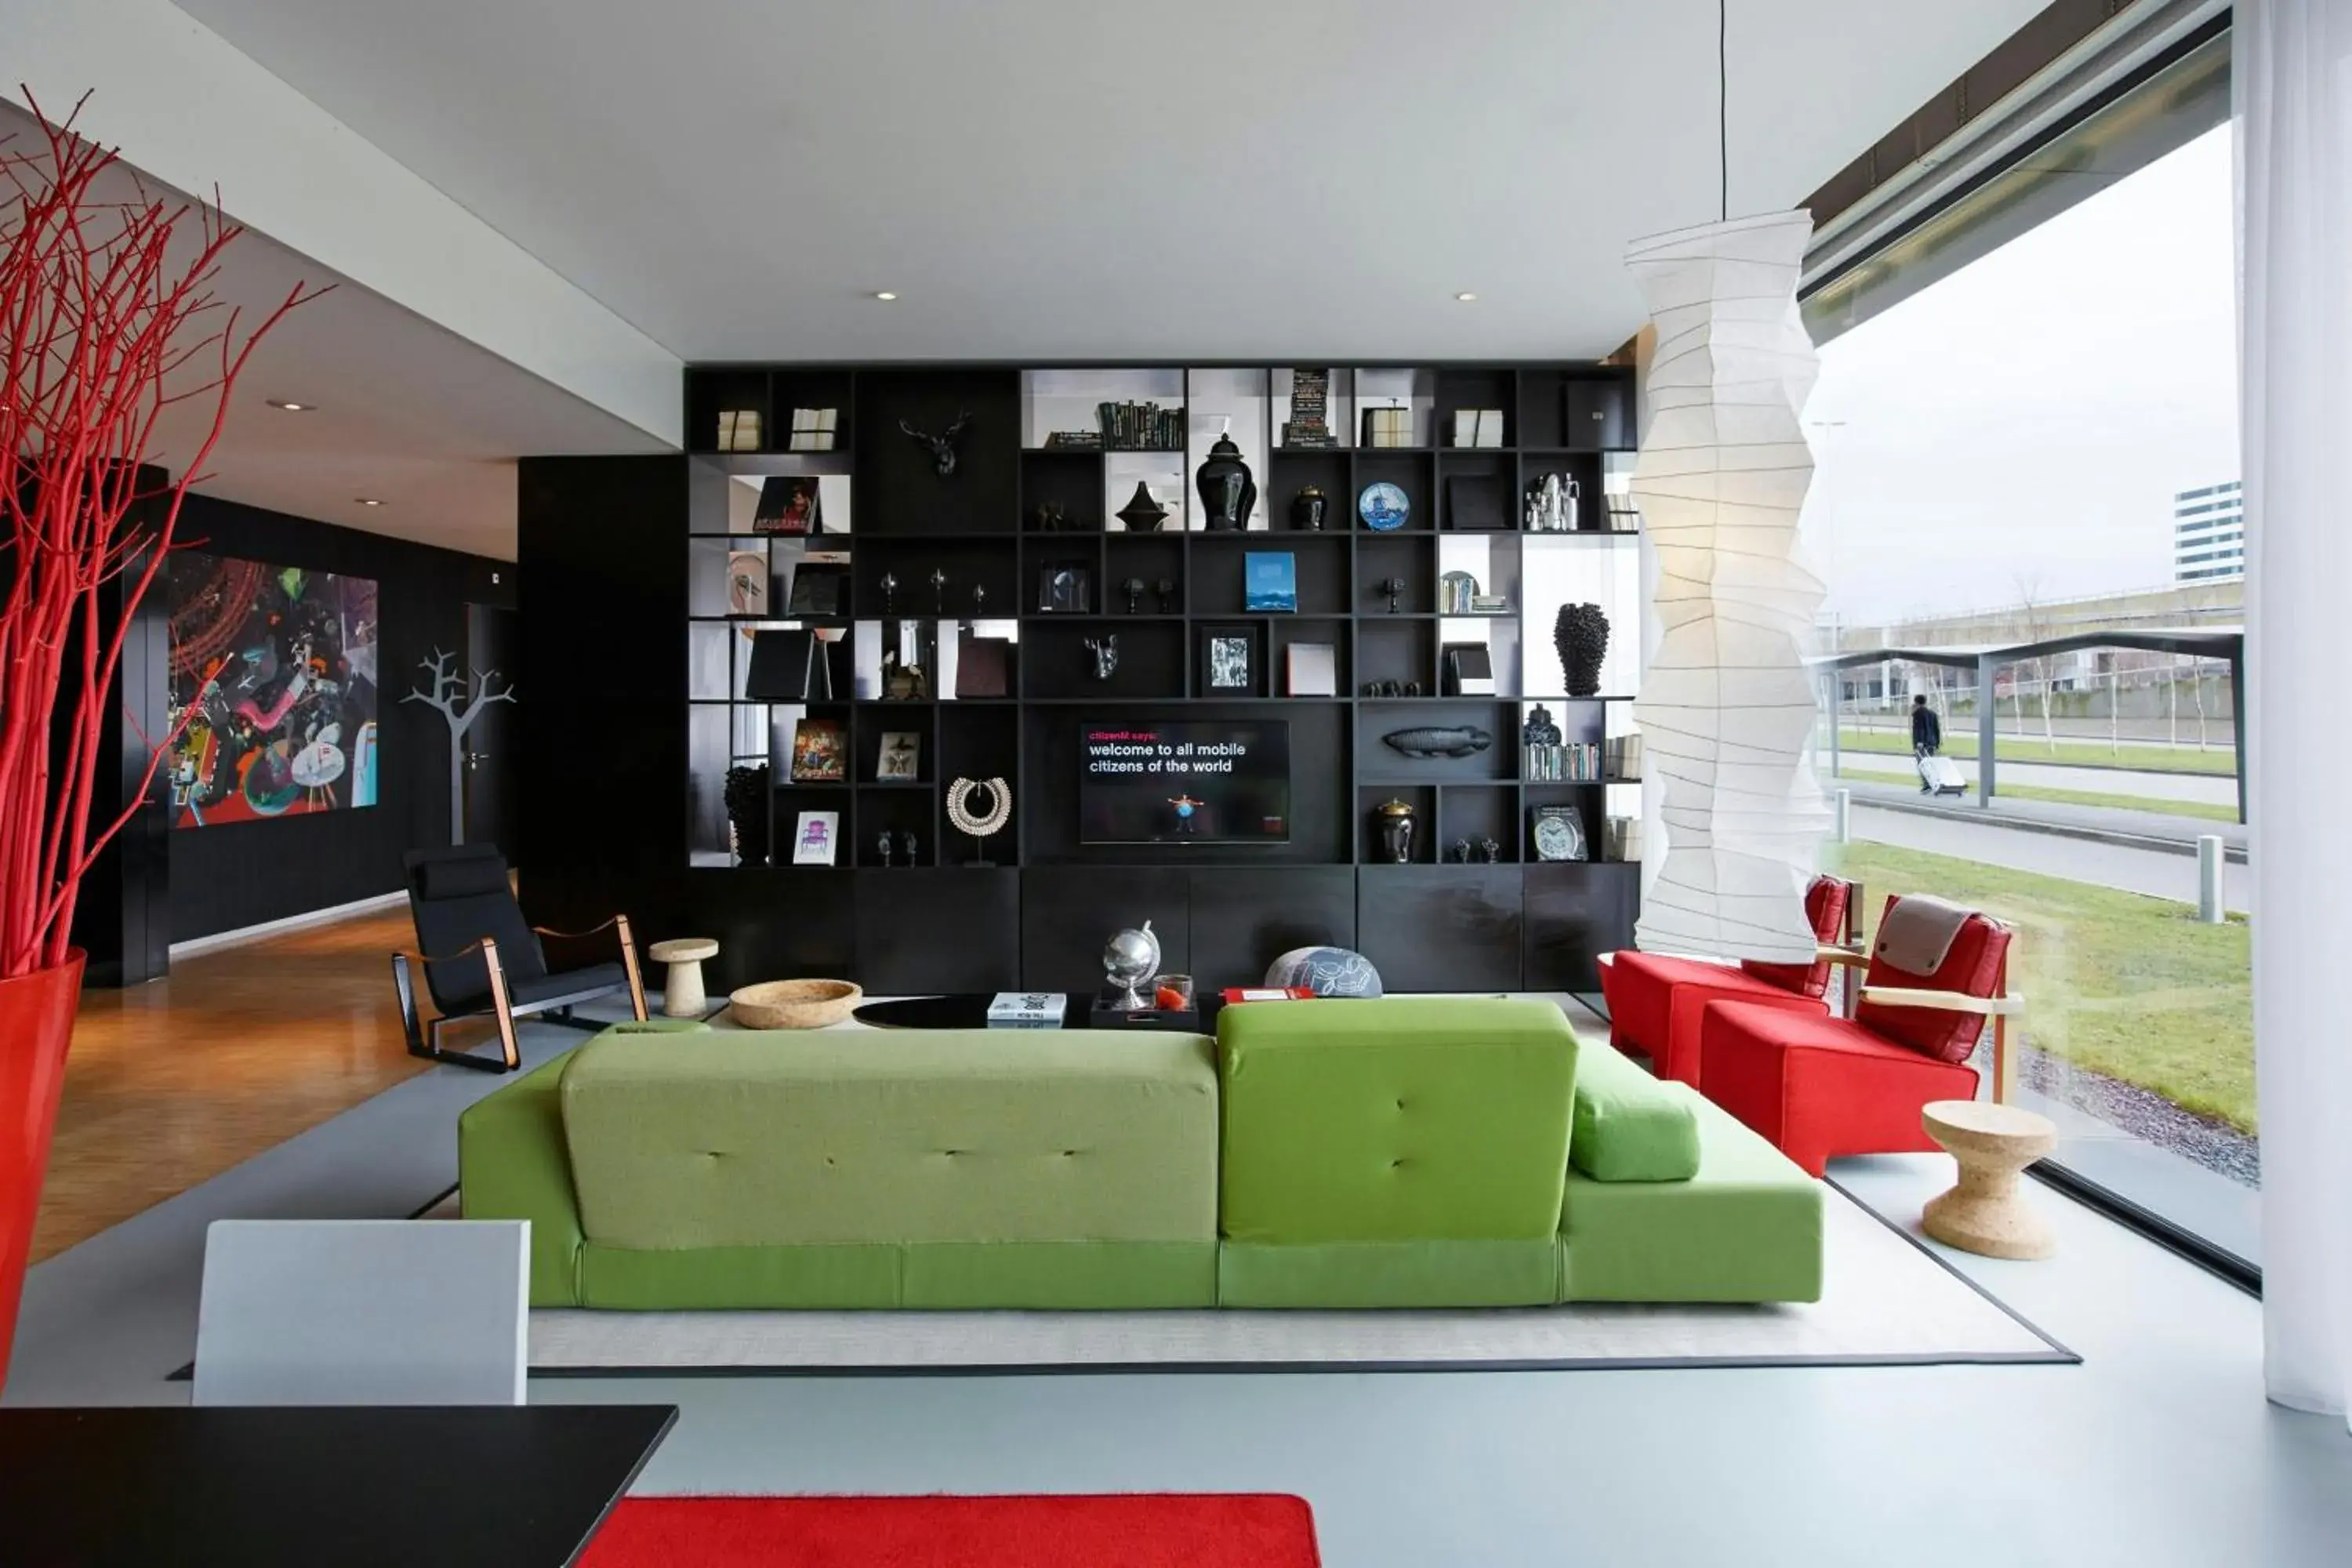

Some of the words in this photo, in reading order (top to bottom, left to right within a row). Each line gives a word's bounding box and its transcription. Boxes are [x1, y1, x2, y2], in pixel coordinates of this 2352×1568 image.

[1089, 742, 1153, 756] welcome
[1158, 743, 1172, 755] to
[1177, 742, 1192, 755] all
[1197, 742, 1246, 755] mobile
[1089, 760, 1144, 772] citizens
[1148, 760, 1162, 772] of
[1166, 759, 1189, 772] the
[1192, 759, 1232, 772] world
